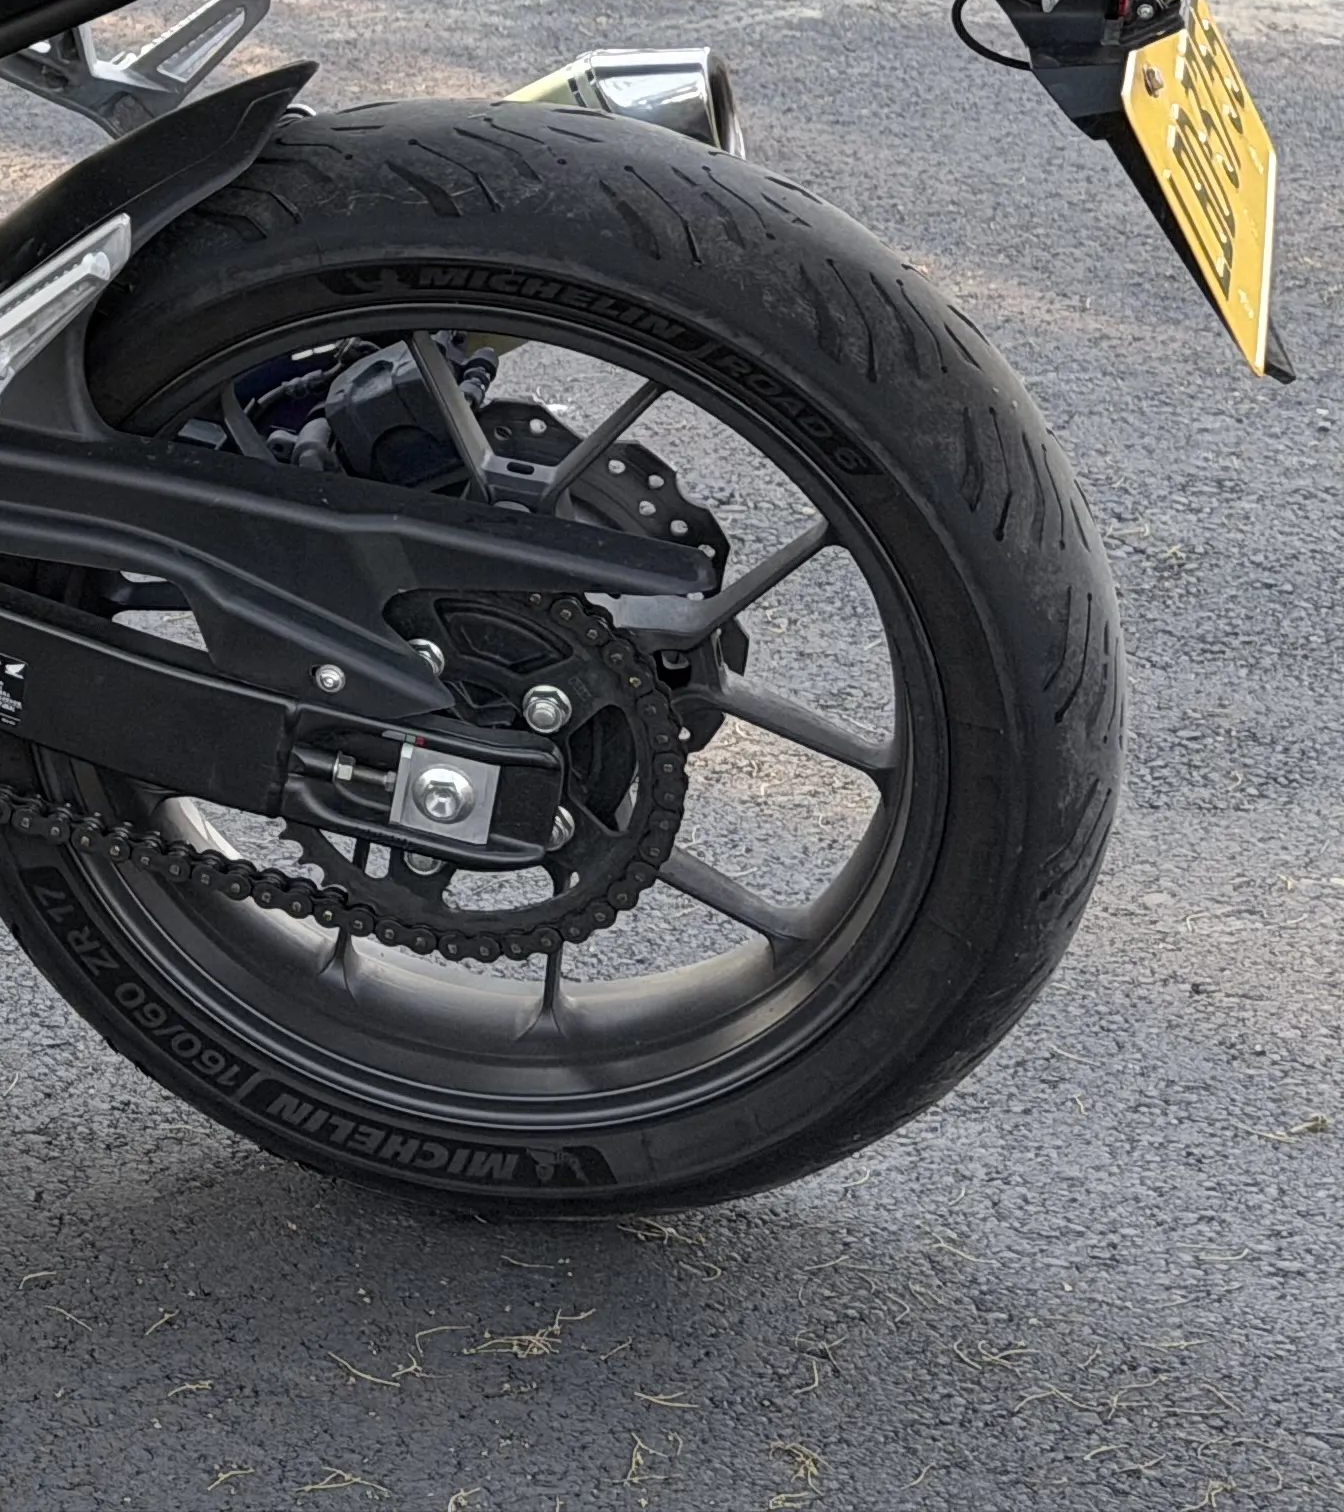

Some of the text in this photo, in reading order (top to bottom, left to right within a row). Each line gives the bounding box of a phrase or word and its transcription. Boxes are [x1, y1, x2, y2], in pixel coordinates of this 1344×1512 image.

[417, 266, 687, 340] MICHELIN
[714, 354, 833, 438] ROAD
[36, 884, 519, 1181] MICHELIN 160/60 ZR 17
